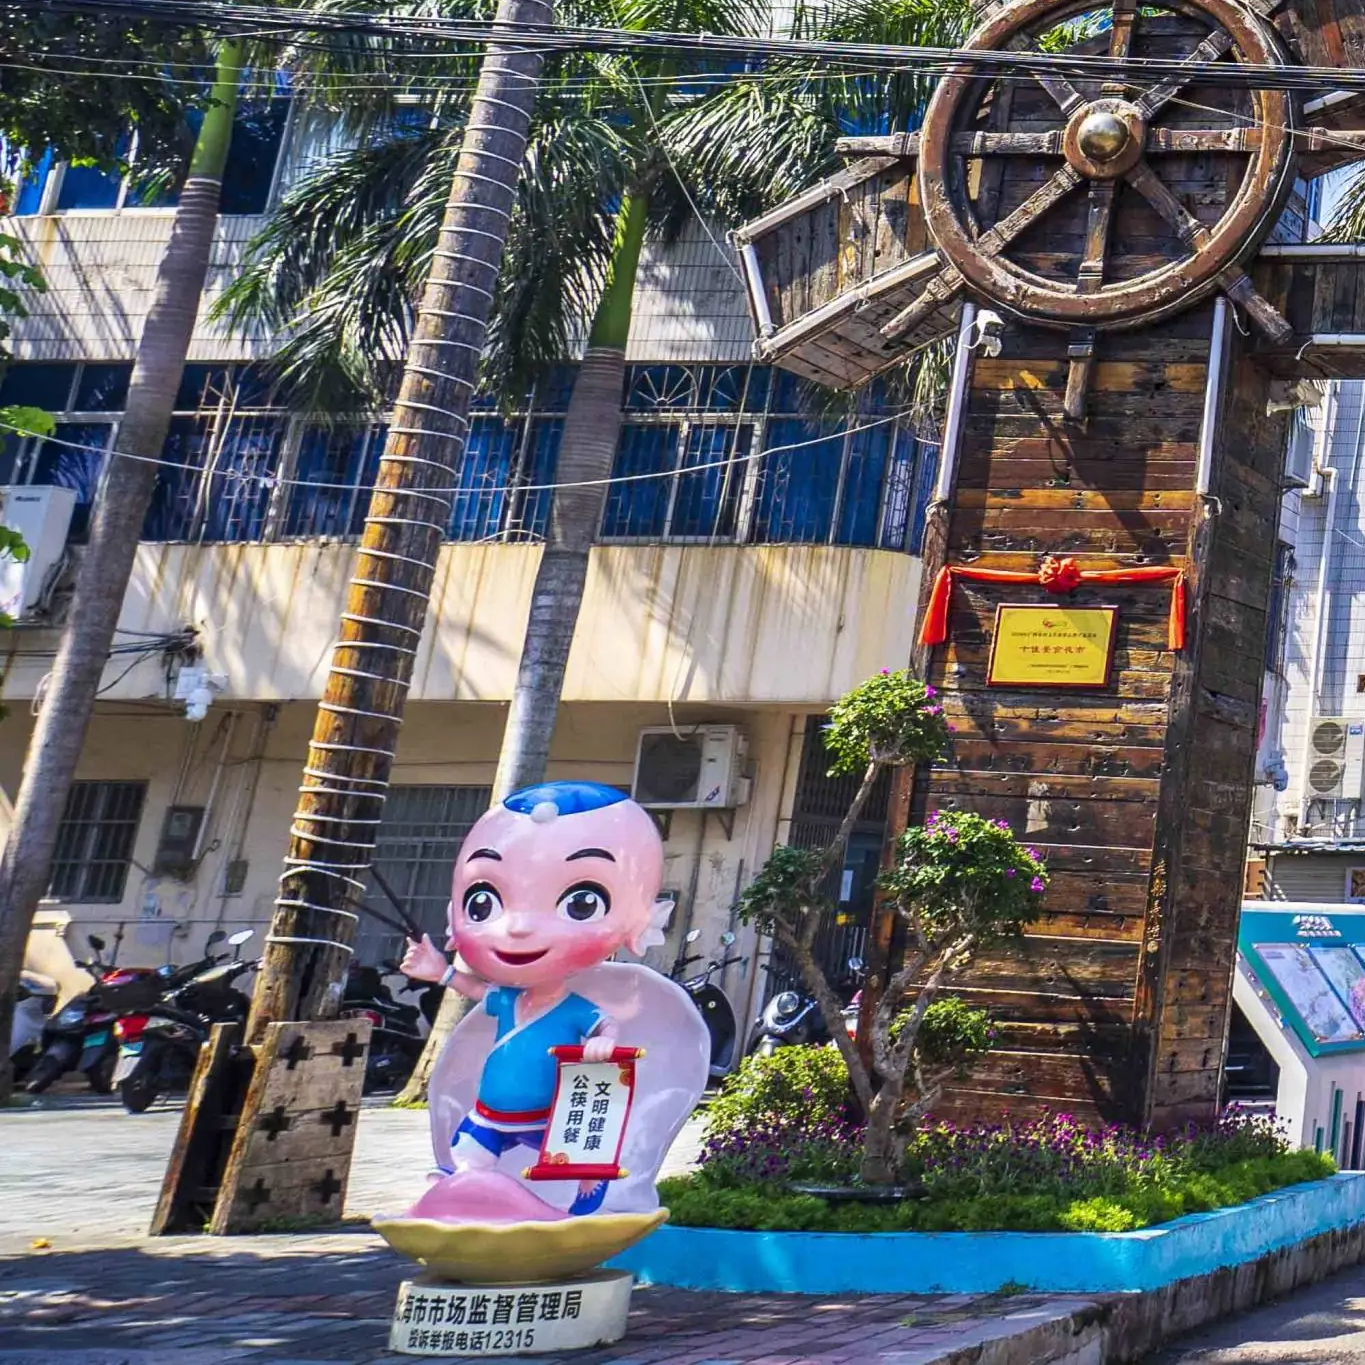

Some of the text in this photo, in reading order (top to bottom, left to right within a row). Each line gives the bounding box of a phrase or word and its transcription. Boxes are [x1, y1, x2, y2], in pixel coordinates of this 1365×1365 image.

[563, 1074, 590, 1144] 公筷用餐
[583, 1081, 612, 1151] 文明健康
[407, 1328, 535, 1351] 投诉举报电话12315
